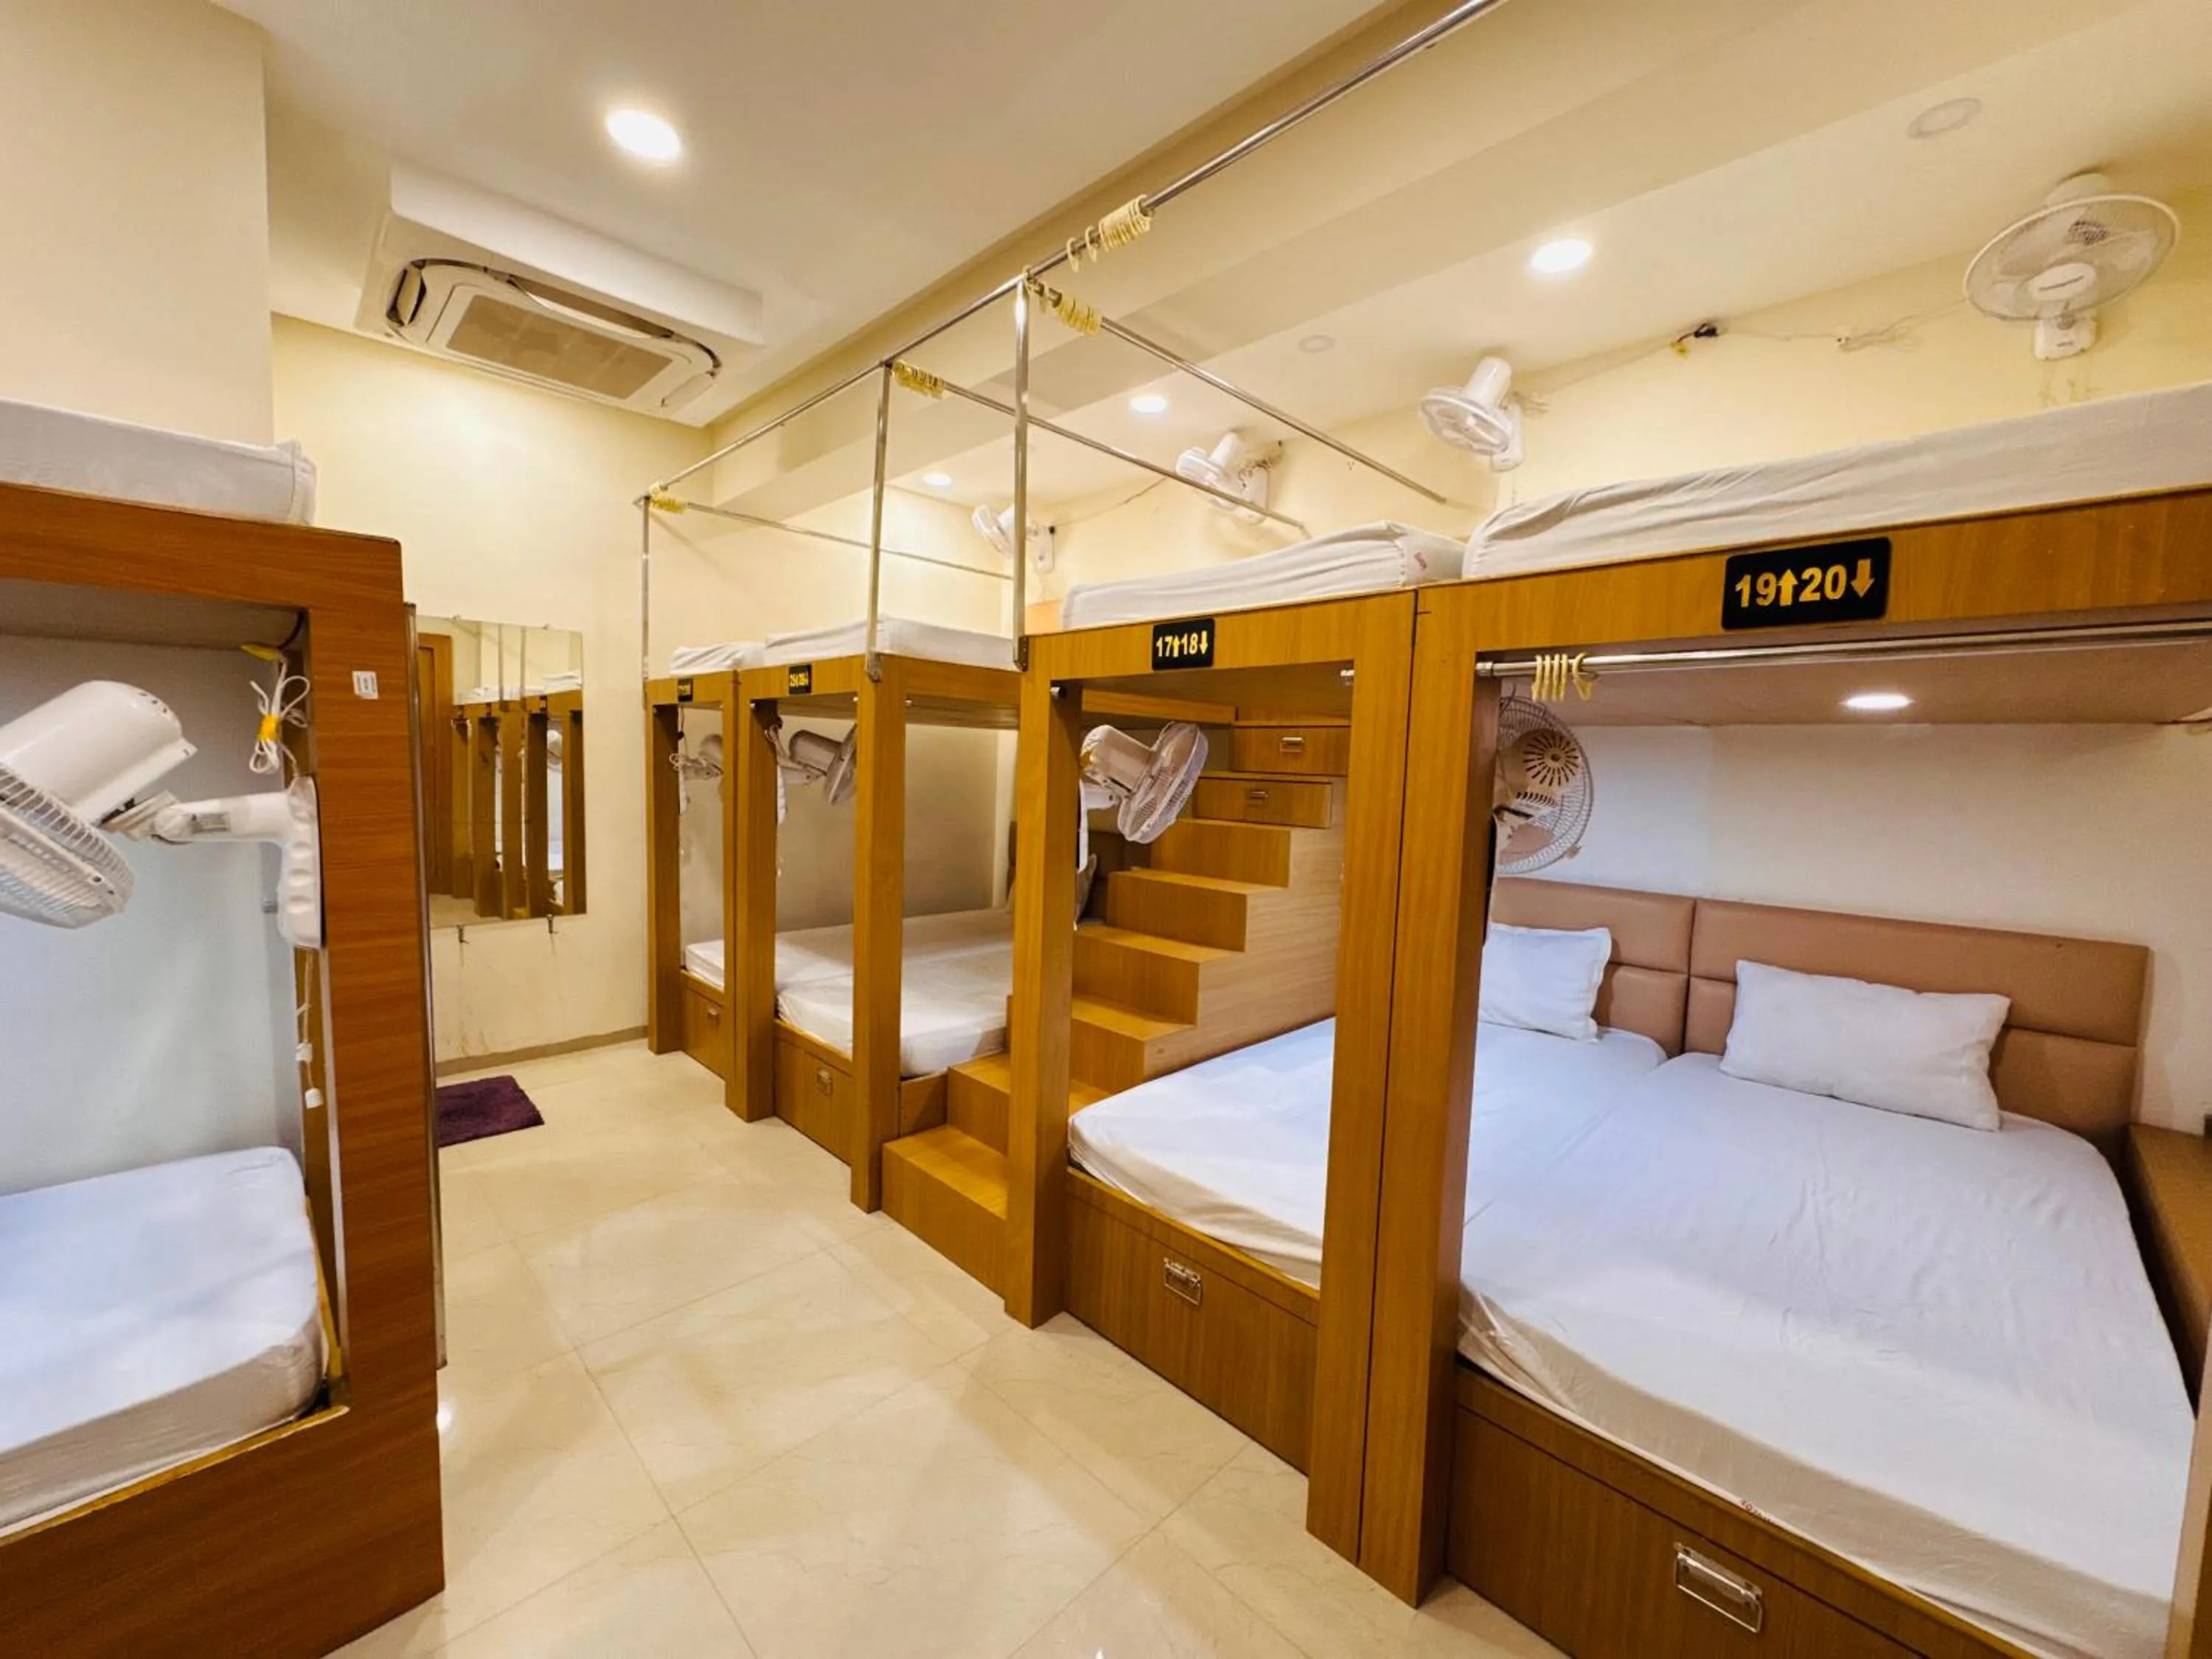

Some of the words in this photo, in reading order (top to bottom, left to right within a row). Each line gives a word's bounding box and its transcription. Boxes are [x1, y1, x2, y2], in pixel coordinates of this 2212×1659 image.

[1735, 572, 1777, 608] 19
[1799, 564, 1847, 602] 20
[1155, 636, 1173, 657] 17
[1181, 632, 1198, 655] 18
